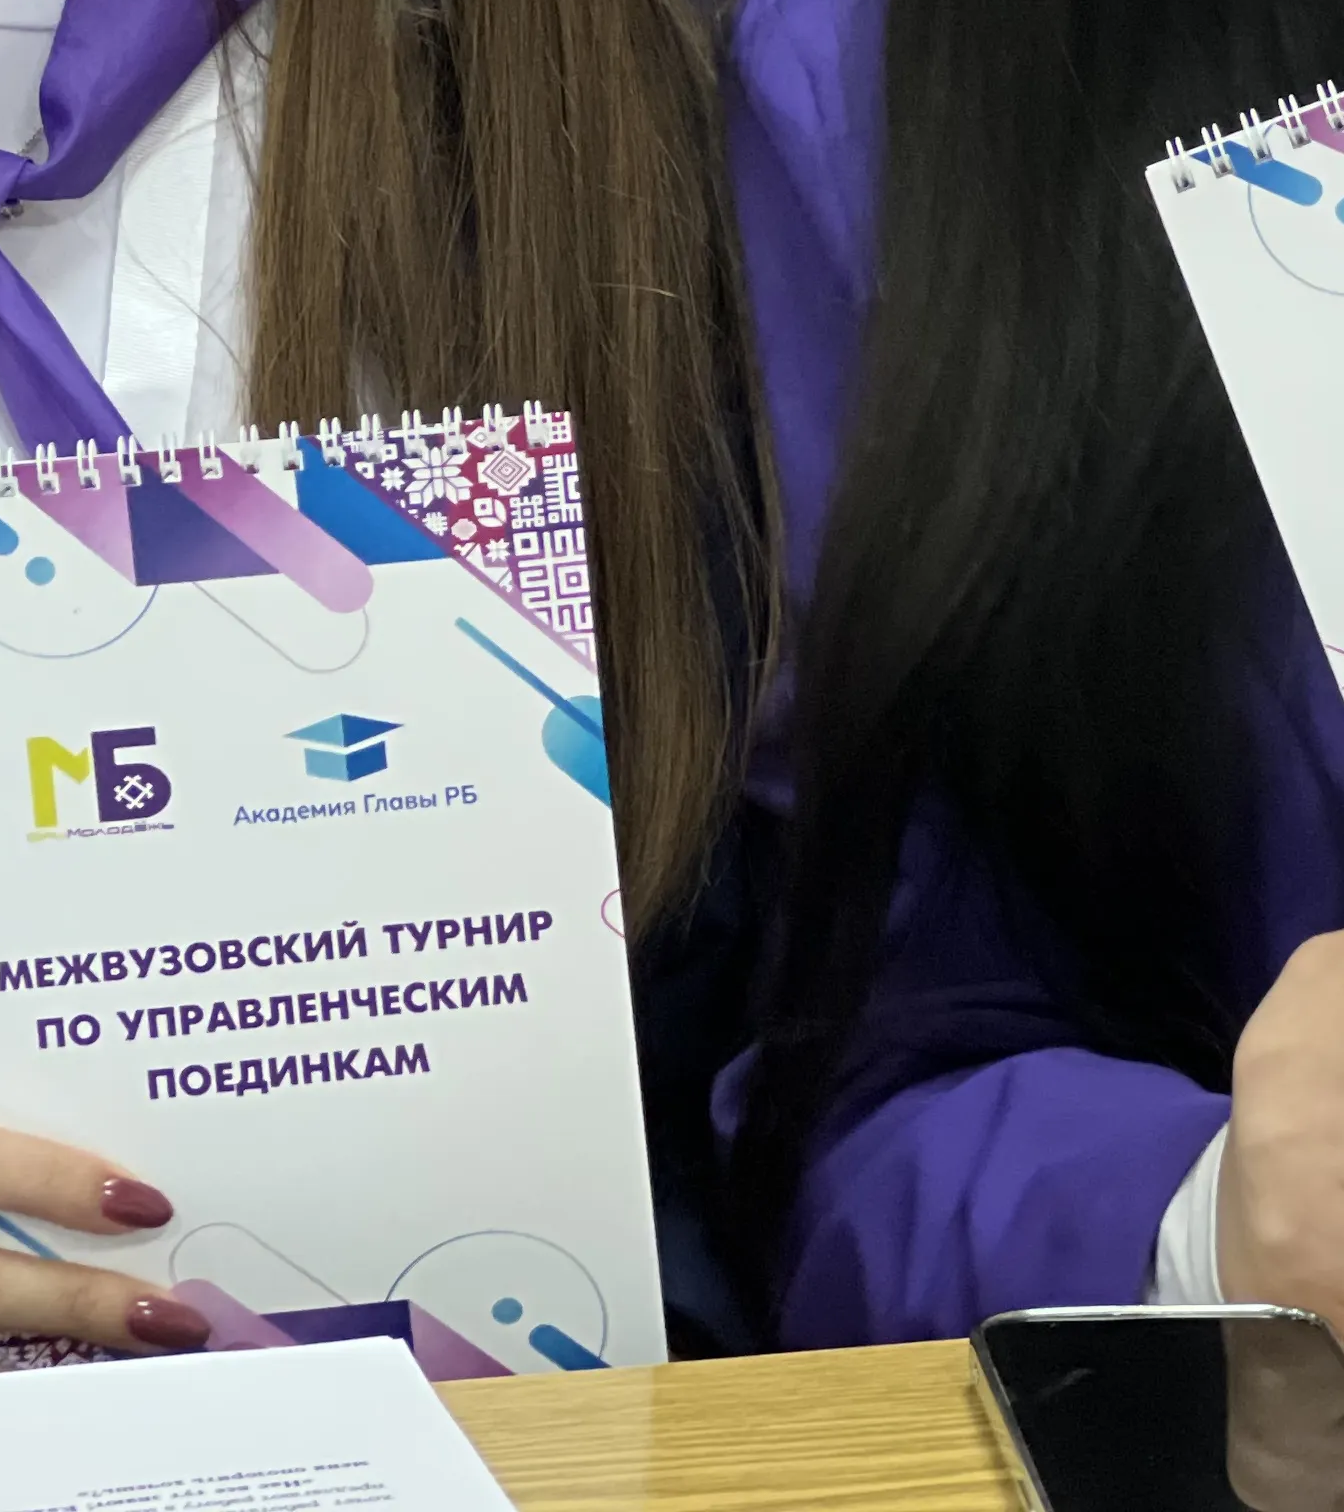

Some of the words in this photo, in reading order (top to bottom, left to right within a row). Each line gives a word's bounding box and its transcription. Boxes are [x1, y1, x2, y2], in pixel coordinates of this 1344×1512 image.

[233, 799, 356, 828] Академия
[363, 792, 438, 814] Главы
[444, 785, 478, 807] РБ
[382, 911, 554, 955] ТУРНИР
[36, 1014, 102, 1050] ПО
[116, 973, 529, 1042] УПРАВЛЕНЧЕСКИМ
[147, 1043, 431, 1101] ПОЕДИНКАМ
